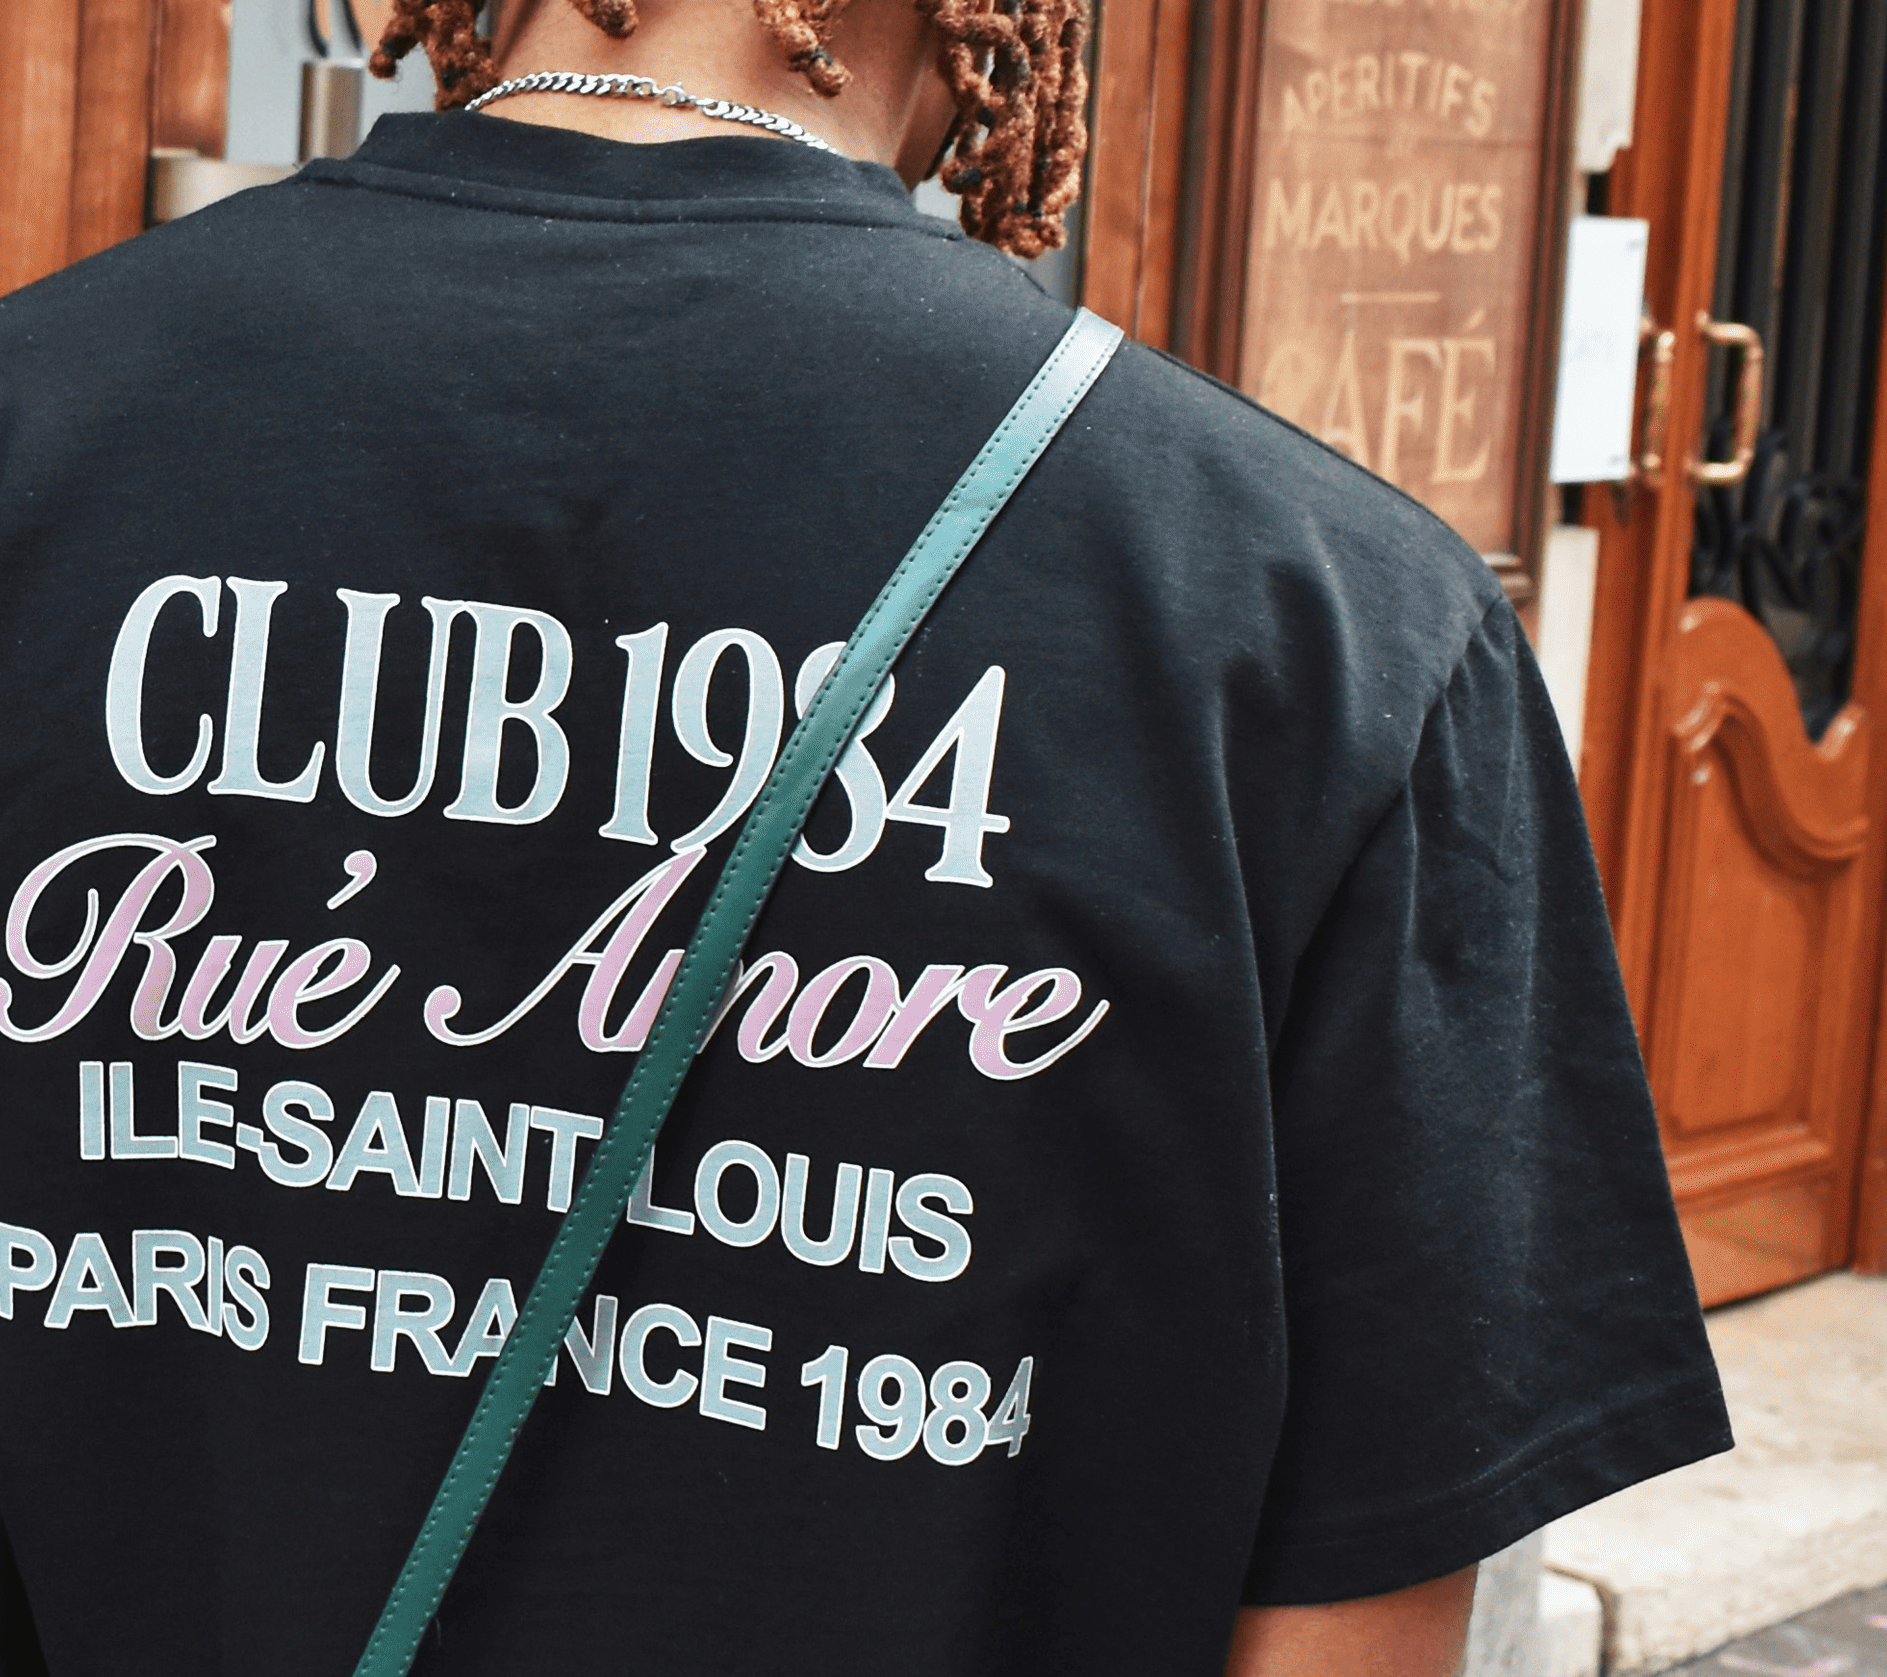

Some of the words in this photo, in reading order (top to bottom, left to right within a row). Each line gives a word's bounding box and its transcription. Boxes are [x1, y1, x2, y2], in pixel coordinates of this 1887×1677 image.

[1263, 177, 1503, 265] MARQUES
[105, 574, 573, 825] CLUB
[598, 621, 1011, 888] 1984
[424, 844, 1110, 1081] Amore
[298, 1262, 774, 1431] FRANCE
[801, 1344, 1035, 1467] 1984
